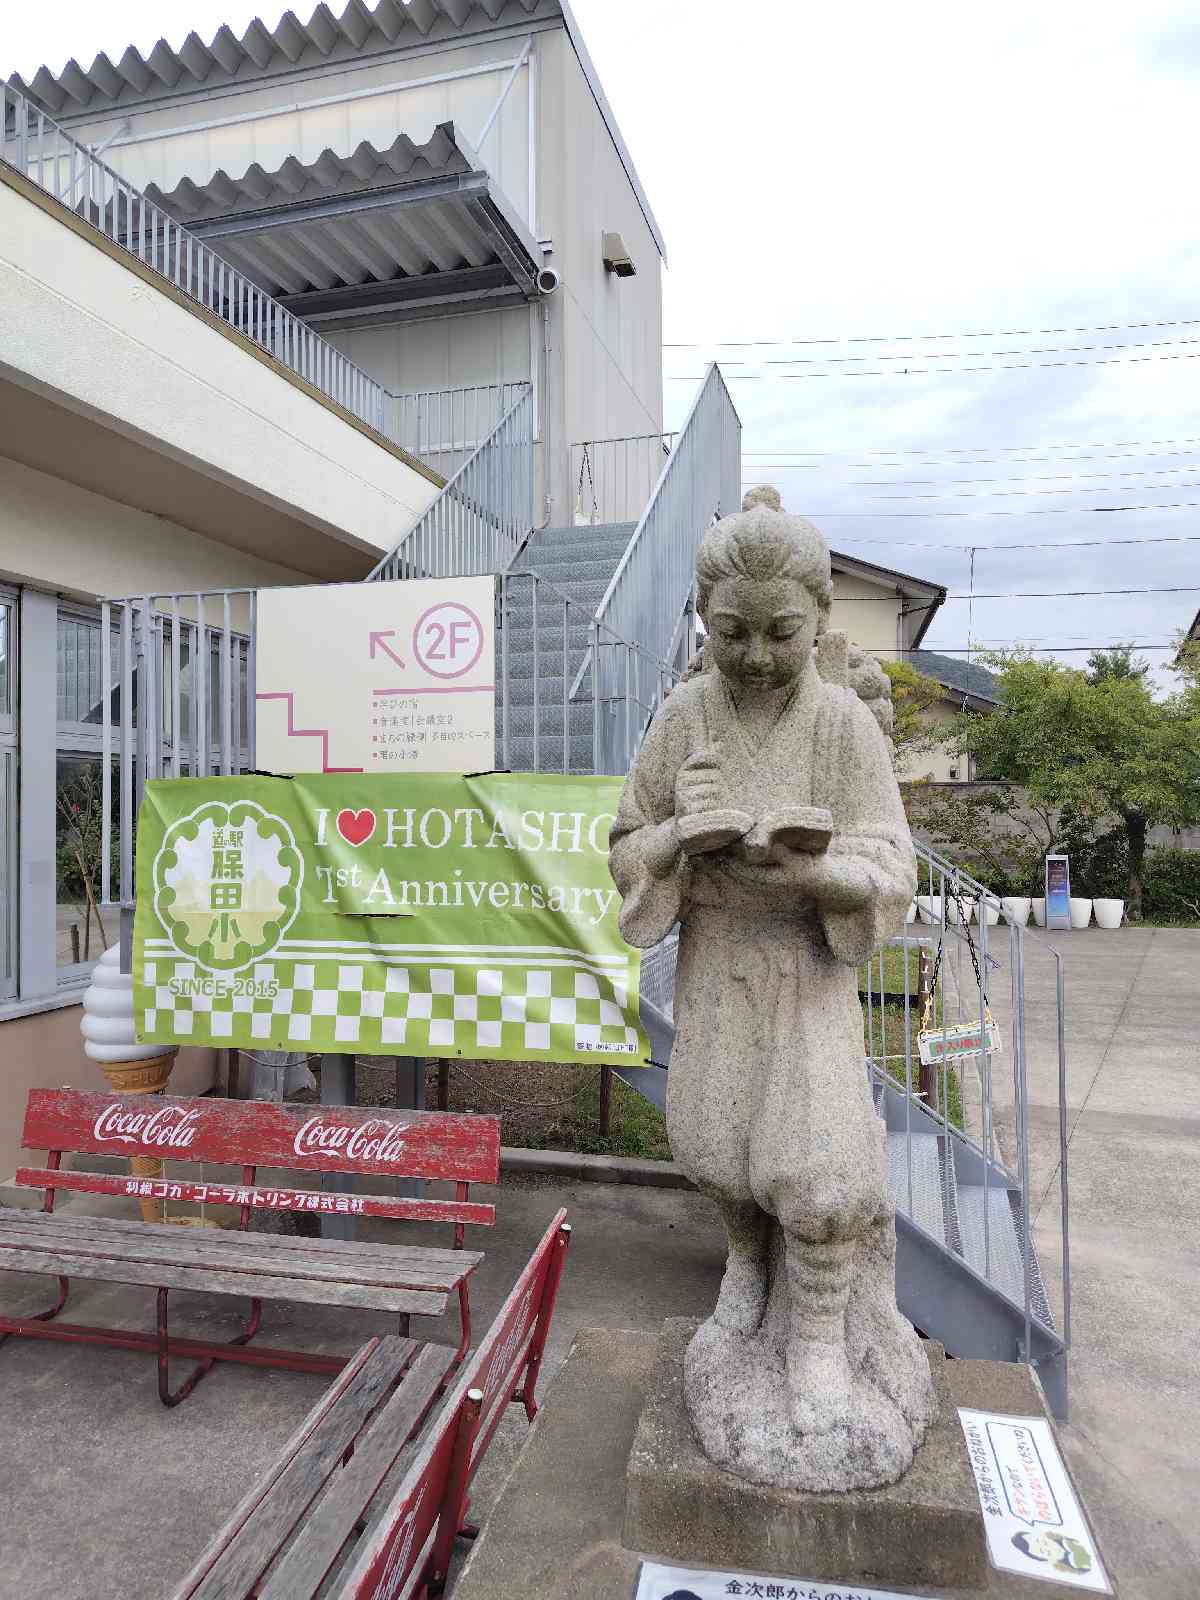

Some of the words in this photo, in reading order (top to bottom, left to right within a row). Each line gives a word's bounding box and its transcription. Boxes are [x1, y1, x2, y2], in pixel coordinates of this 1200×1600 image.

[424, 621, 471, 660] 2F
[362, 867, 616, 925] Anniversary
[168, 978, 227, 997] SINCE
[233, 979, 280, 999] 2015
